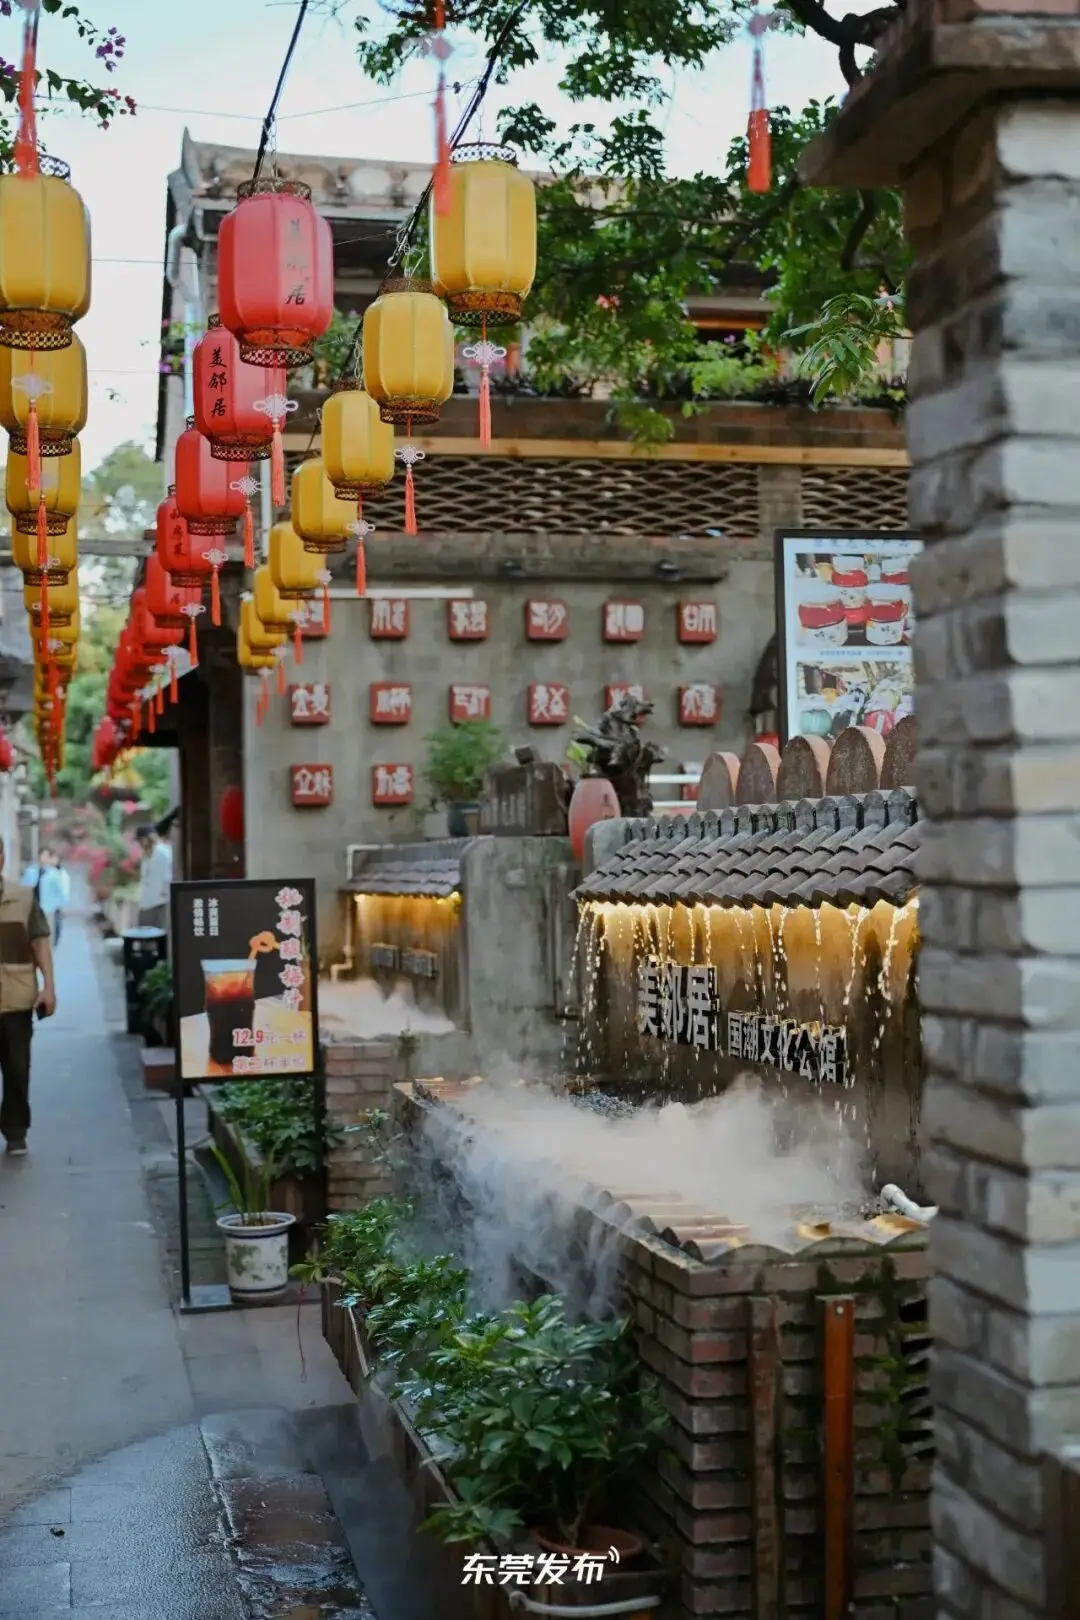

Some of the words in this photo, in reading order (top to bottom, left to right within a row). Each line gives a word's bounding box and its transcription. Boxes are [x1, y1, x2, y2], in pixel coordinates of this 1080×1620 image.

[208, 345, 227, 418] 美邻居
[637, 956, 716, 1050] 美邻居
[728, 1012, 847, 1083] 国潮文化公馆
